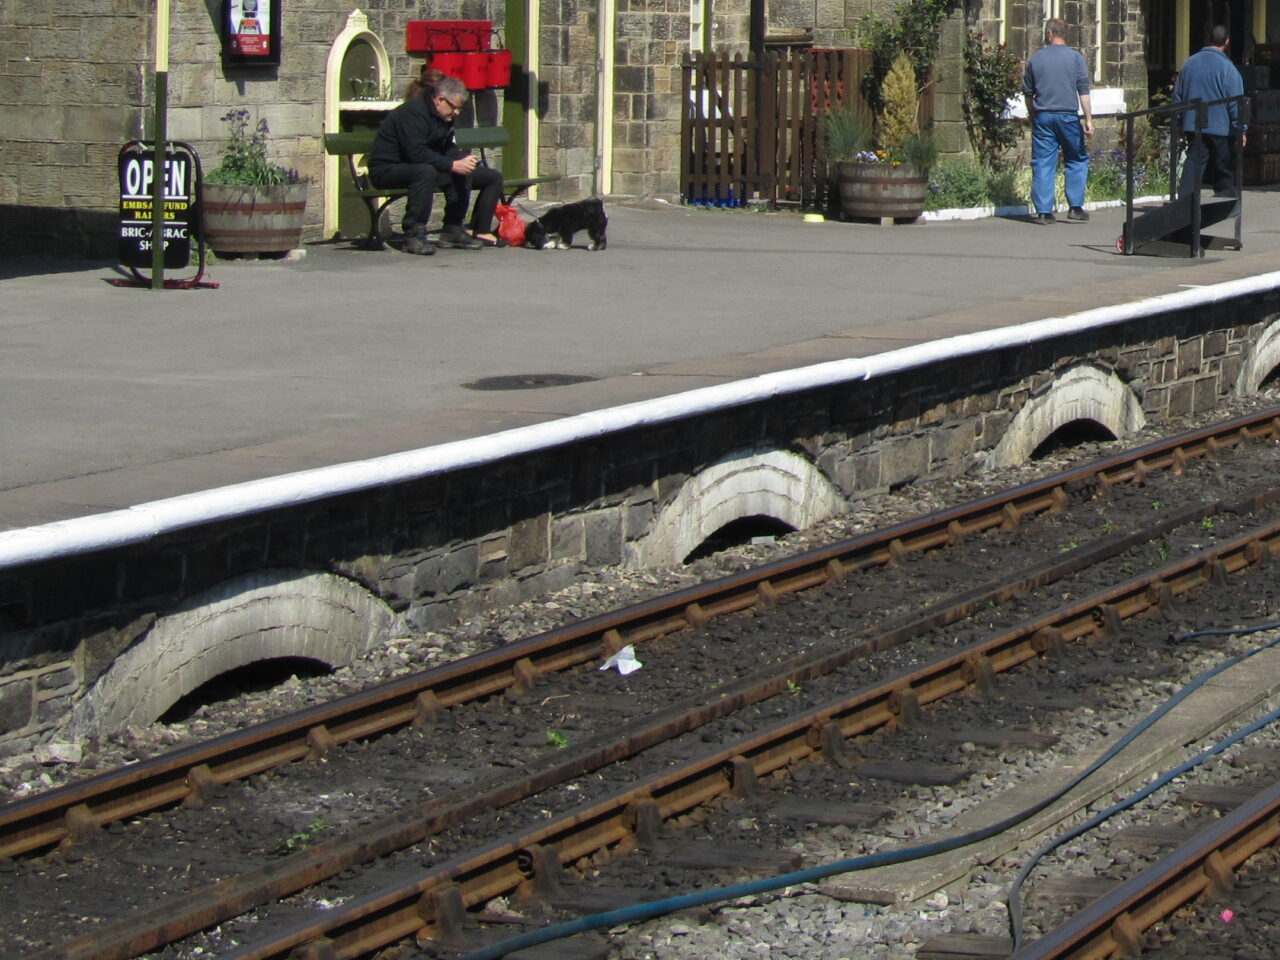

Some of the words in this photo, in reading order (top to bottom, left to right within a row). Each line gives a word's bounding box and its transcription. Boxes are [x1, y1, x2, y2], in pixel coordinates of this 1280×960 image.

[122, 200, 153, 210] EMBSA
[164, 201, 188, 210] FUND
[134, 212, 176, 220] RAIRS
[121, 227, 188, 239] BRIC-RAC
[139, 240, 170, 251] SHP
